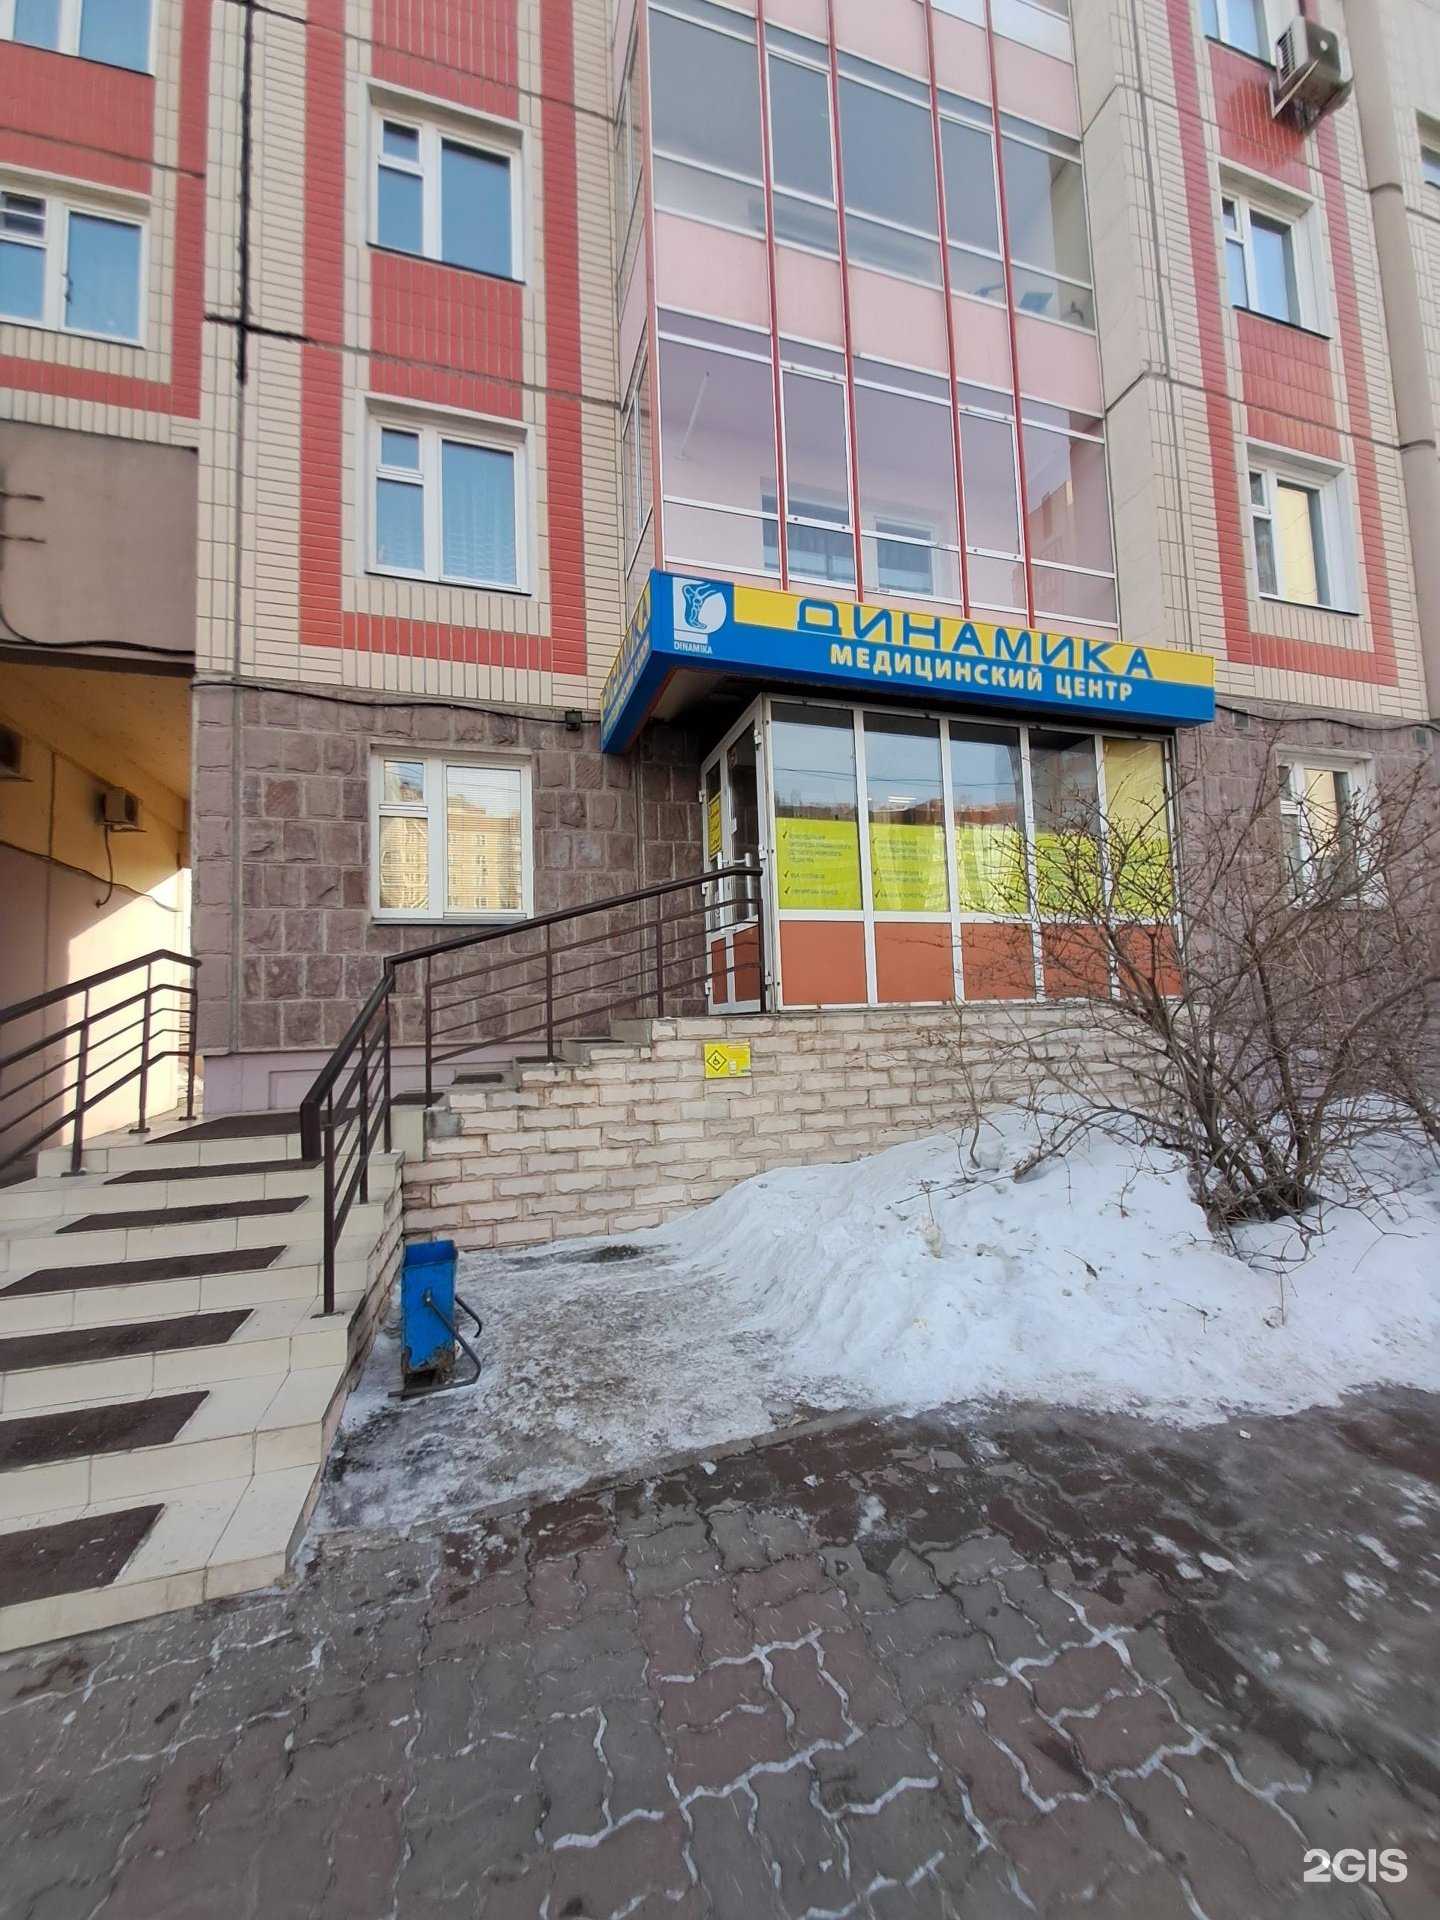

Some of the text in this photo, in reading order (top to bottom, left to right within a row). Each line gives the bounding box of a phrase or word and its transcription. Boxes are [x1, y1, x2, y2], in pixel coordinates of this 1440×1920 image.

[674, 640, 713, 654] DINAMIKA
[797, 598, 1153, 679] ДИНАМИКА
[830, 643, 1132, 701] МЕДИЦИНСКИЙ ЦЕНТР
